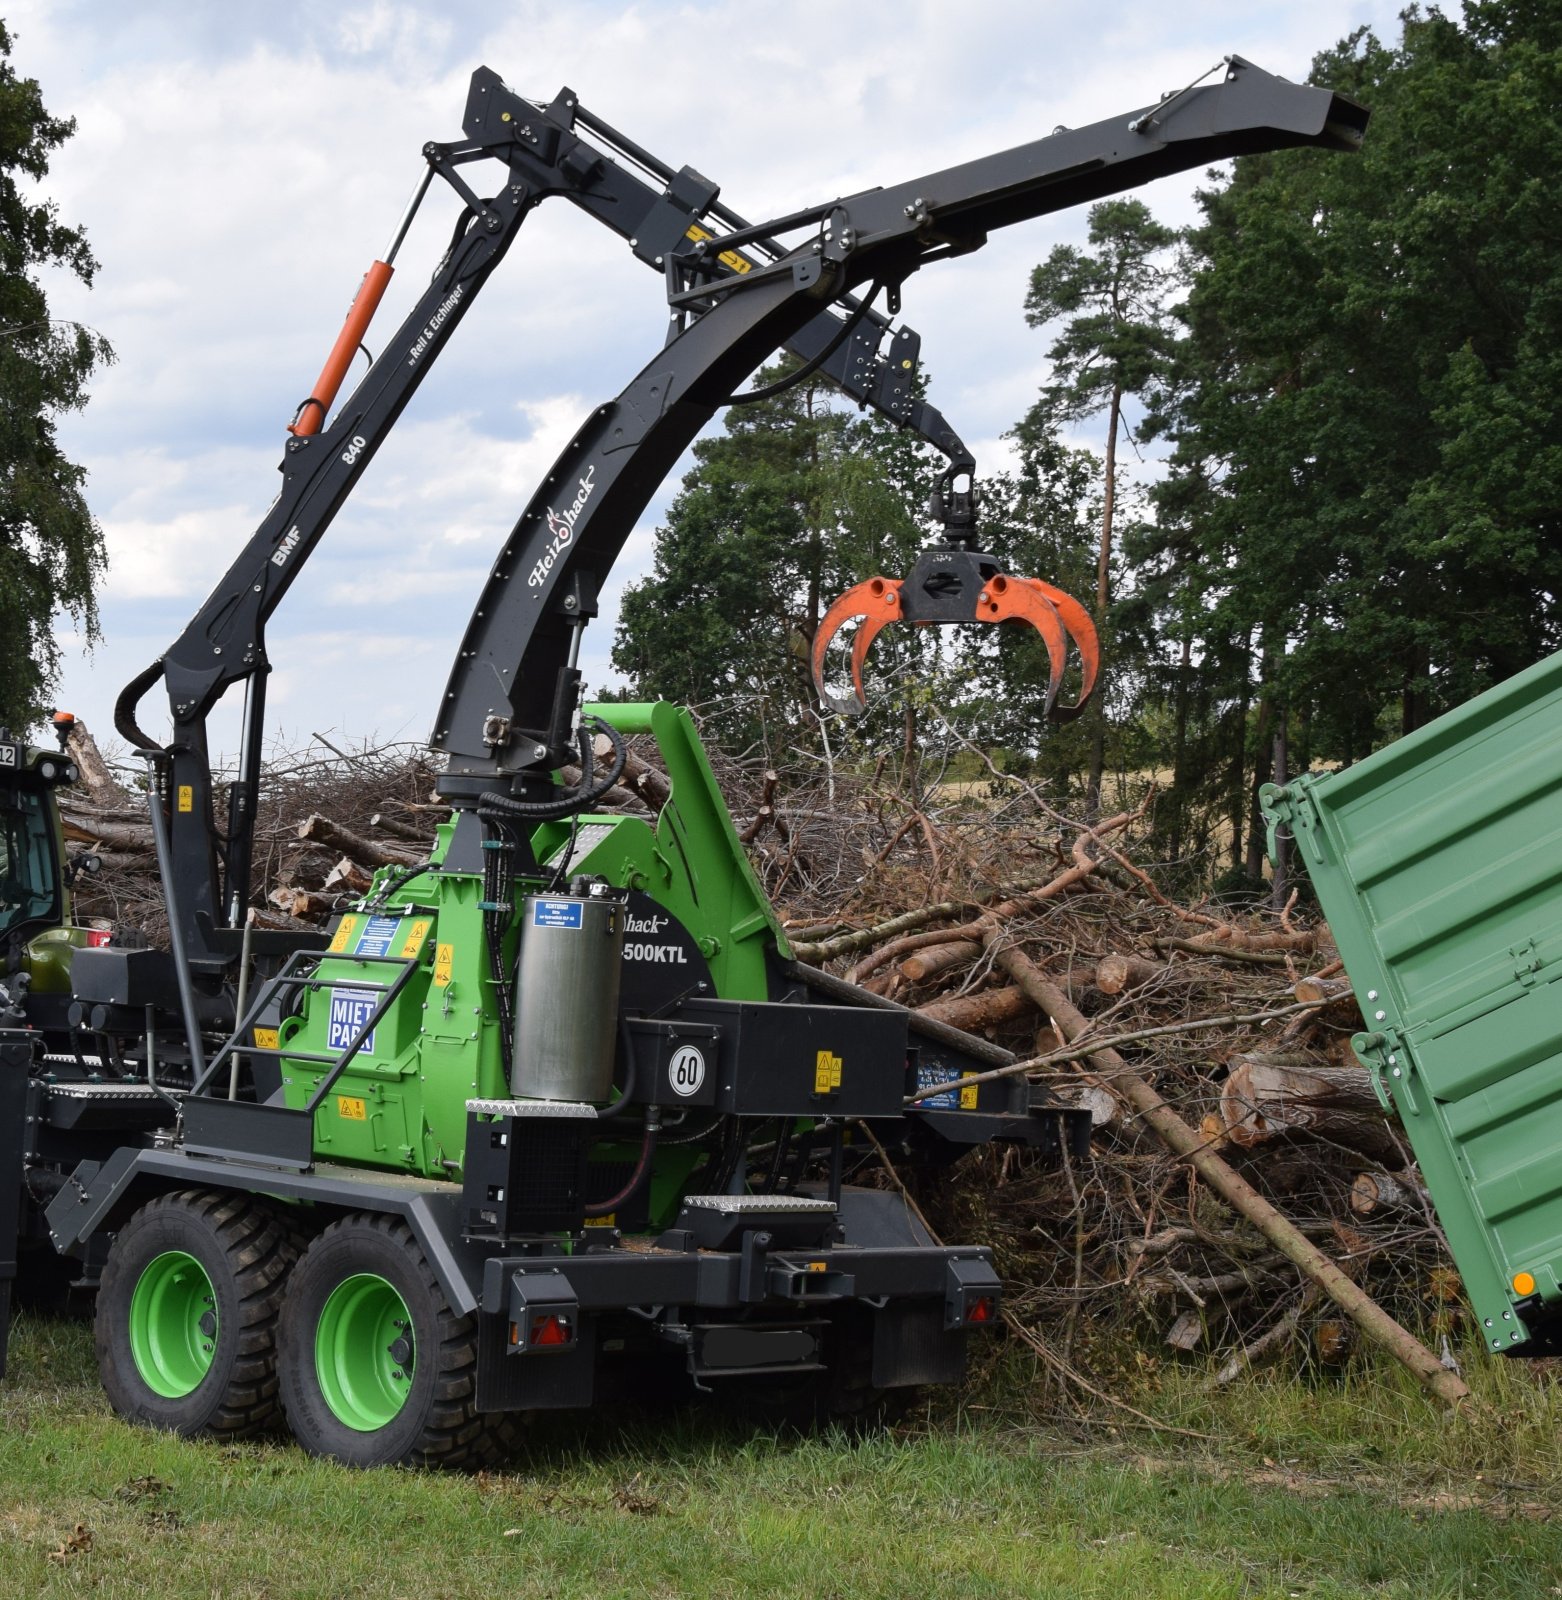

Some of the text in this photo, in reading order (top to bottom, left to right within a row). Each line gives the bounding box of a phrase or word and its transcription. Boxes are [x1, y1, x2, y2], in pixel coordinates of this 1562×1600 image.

[410, 336, 428, 359] Reil
[423, 328, 434, 340] &
[429, 284, 464, 331] Eichinger
[341, 435, 367, 465] 840
[271, 525, 301, 567] BMF
[622, 913, 669, 934] hack
[621, 943, 688, 964] 500KTL
[333, 1000, 374, 1025] MIET
[677, 1055, 698, 1086] 60
